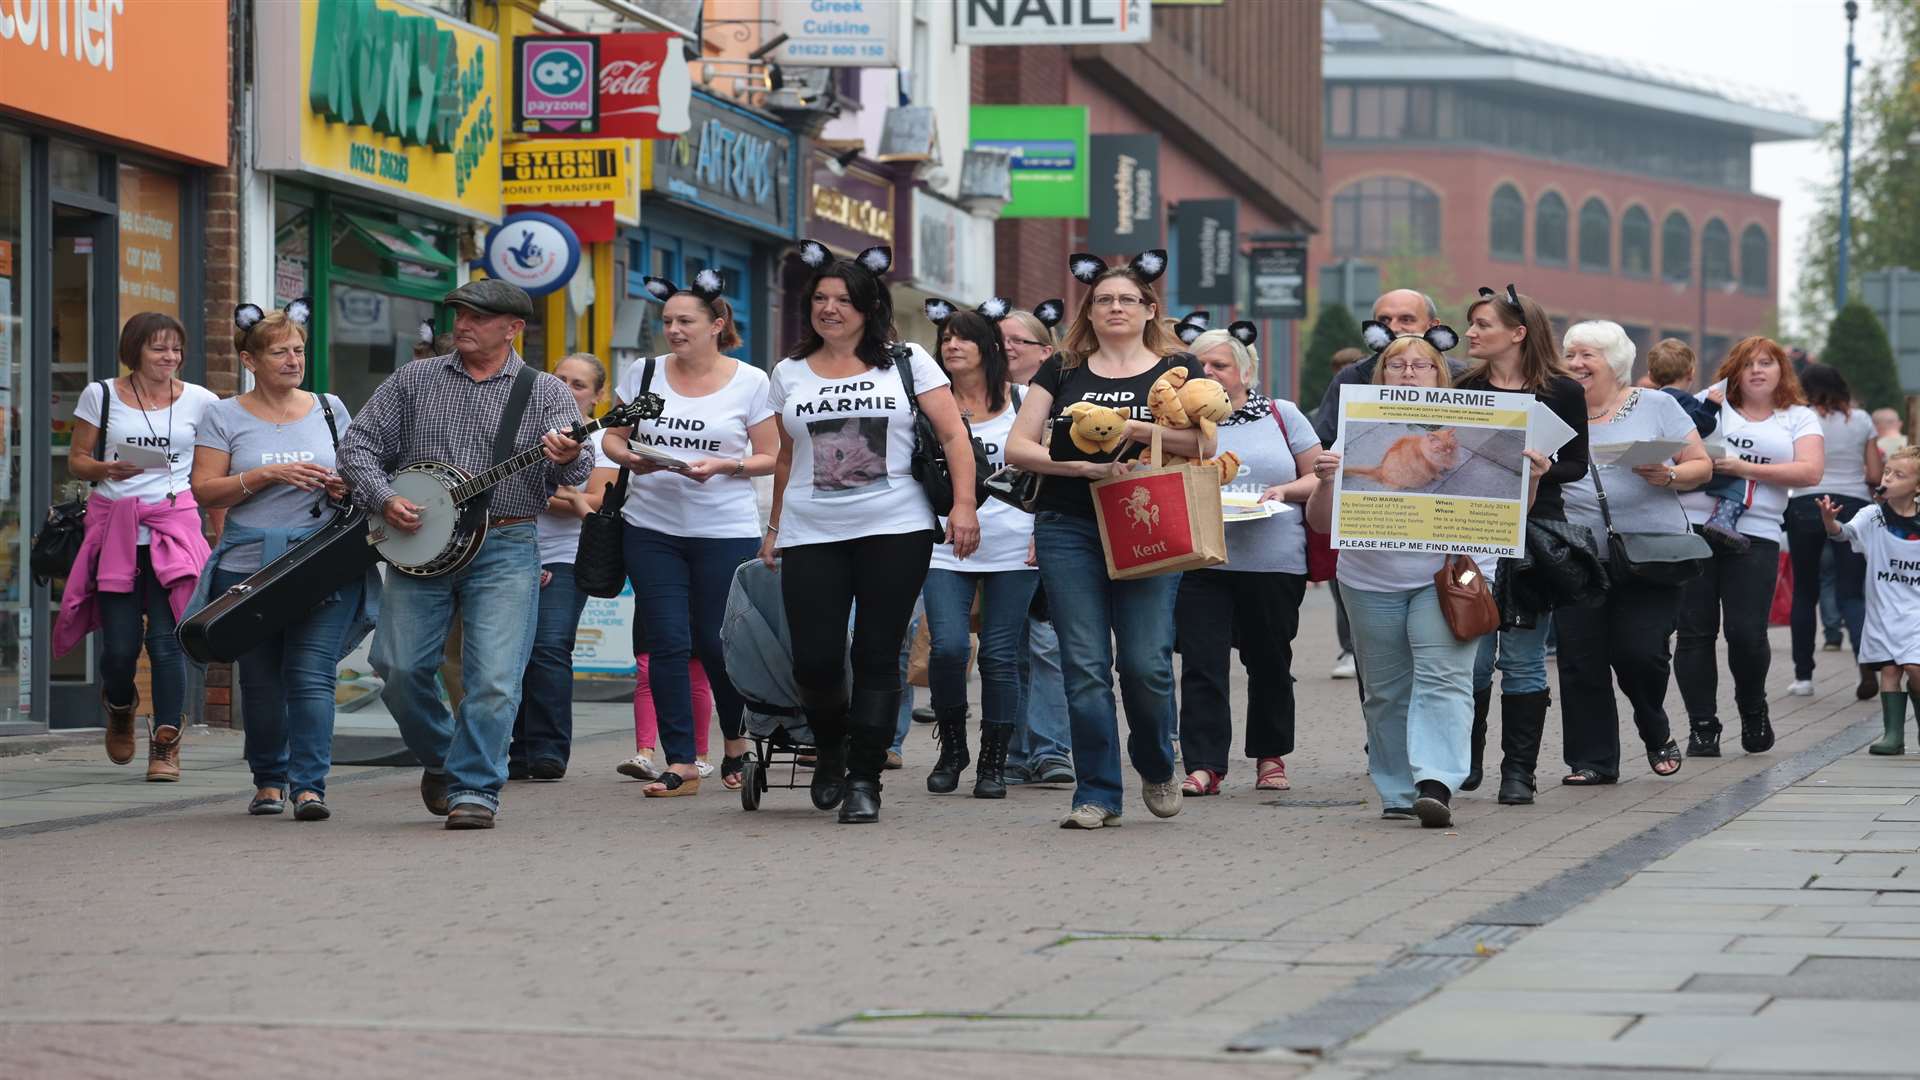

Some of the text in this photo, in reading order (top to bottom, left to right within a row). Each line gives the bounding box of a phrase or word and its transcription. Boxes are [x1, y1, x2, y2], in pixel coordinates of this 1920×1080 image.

[811, 0, 864, 12] Greek
[967, 0, 1115, 27] NAIL
[1128, 0, 1140, 24] AR
[803, 19, 870, 34] Cuisine
[788, 44, 828, 56] 01622
[527, 100, 588, 114] payzone
[502, 150, 594, 167] ESTERN
[515, 164, 595, 180] UNION
[547, 182, 612, 194] TRANSFER
[126, 244, 163, 275] car park
[819, 381, 875, 395] FIND
[1081, 391, 1136, 402] FIND
[1380, 389, 1496, 407] FIND MARMIE
[796, 397, 896, 417] MARMIE
[655, 417, 706, 432] FIND
[126, 436, 170, 447] FIND
[641, 433, 722, 452] MARMIE
[1727, 437, 1754, 449] ND
[261, 452, 315, 465] FIND
[1739, 453, 1772, 465] MIE
[1132, 540, 1168, 558] Kent
[1339, 540, 1377, 548] PLEASE
[1380, 541, 1406, 549] HELP
[1425, 543, 1449, 551] FIND
[1451, 544, 1515, 556] MARMALADE
[1877, 571, 1920, 587] MARM
